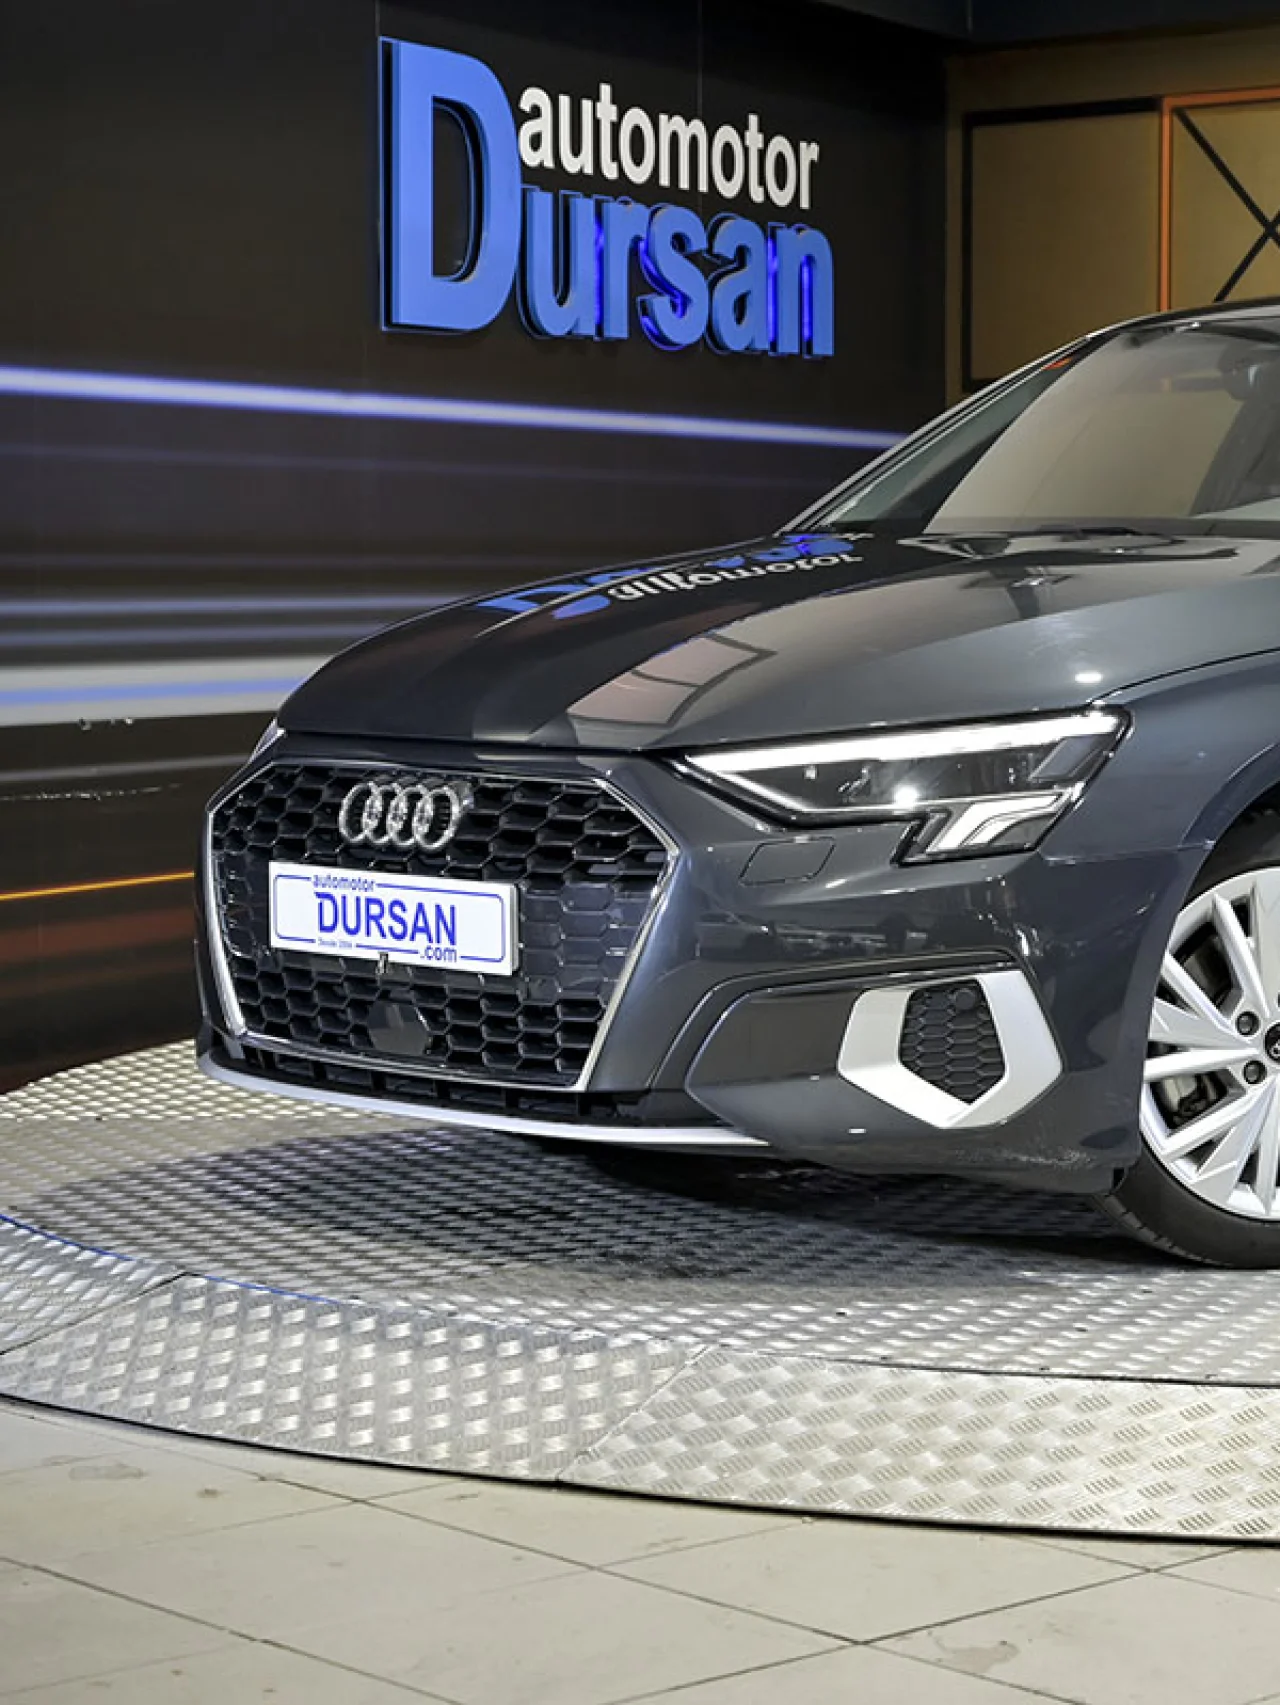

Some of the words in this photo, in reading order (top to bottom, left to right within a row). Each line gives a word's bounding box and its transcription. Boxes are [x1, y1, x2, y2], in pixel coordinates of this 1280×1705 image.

[518, 82, 820, 210] automotor
[379, 35, 835, 358] Dursan
[312, 873, 375, 892] automotor
[314, 891, 457, 946] DURSAN
[420, 945, 458, 963] .com
